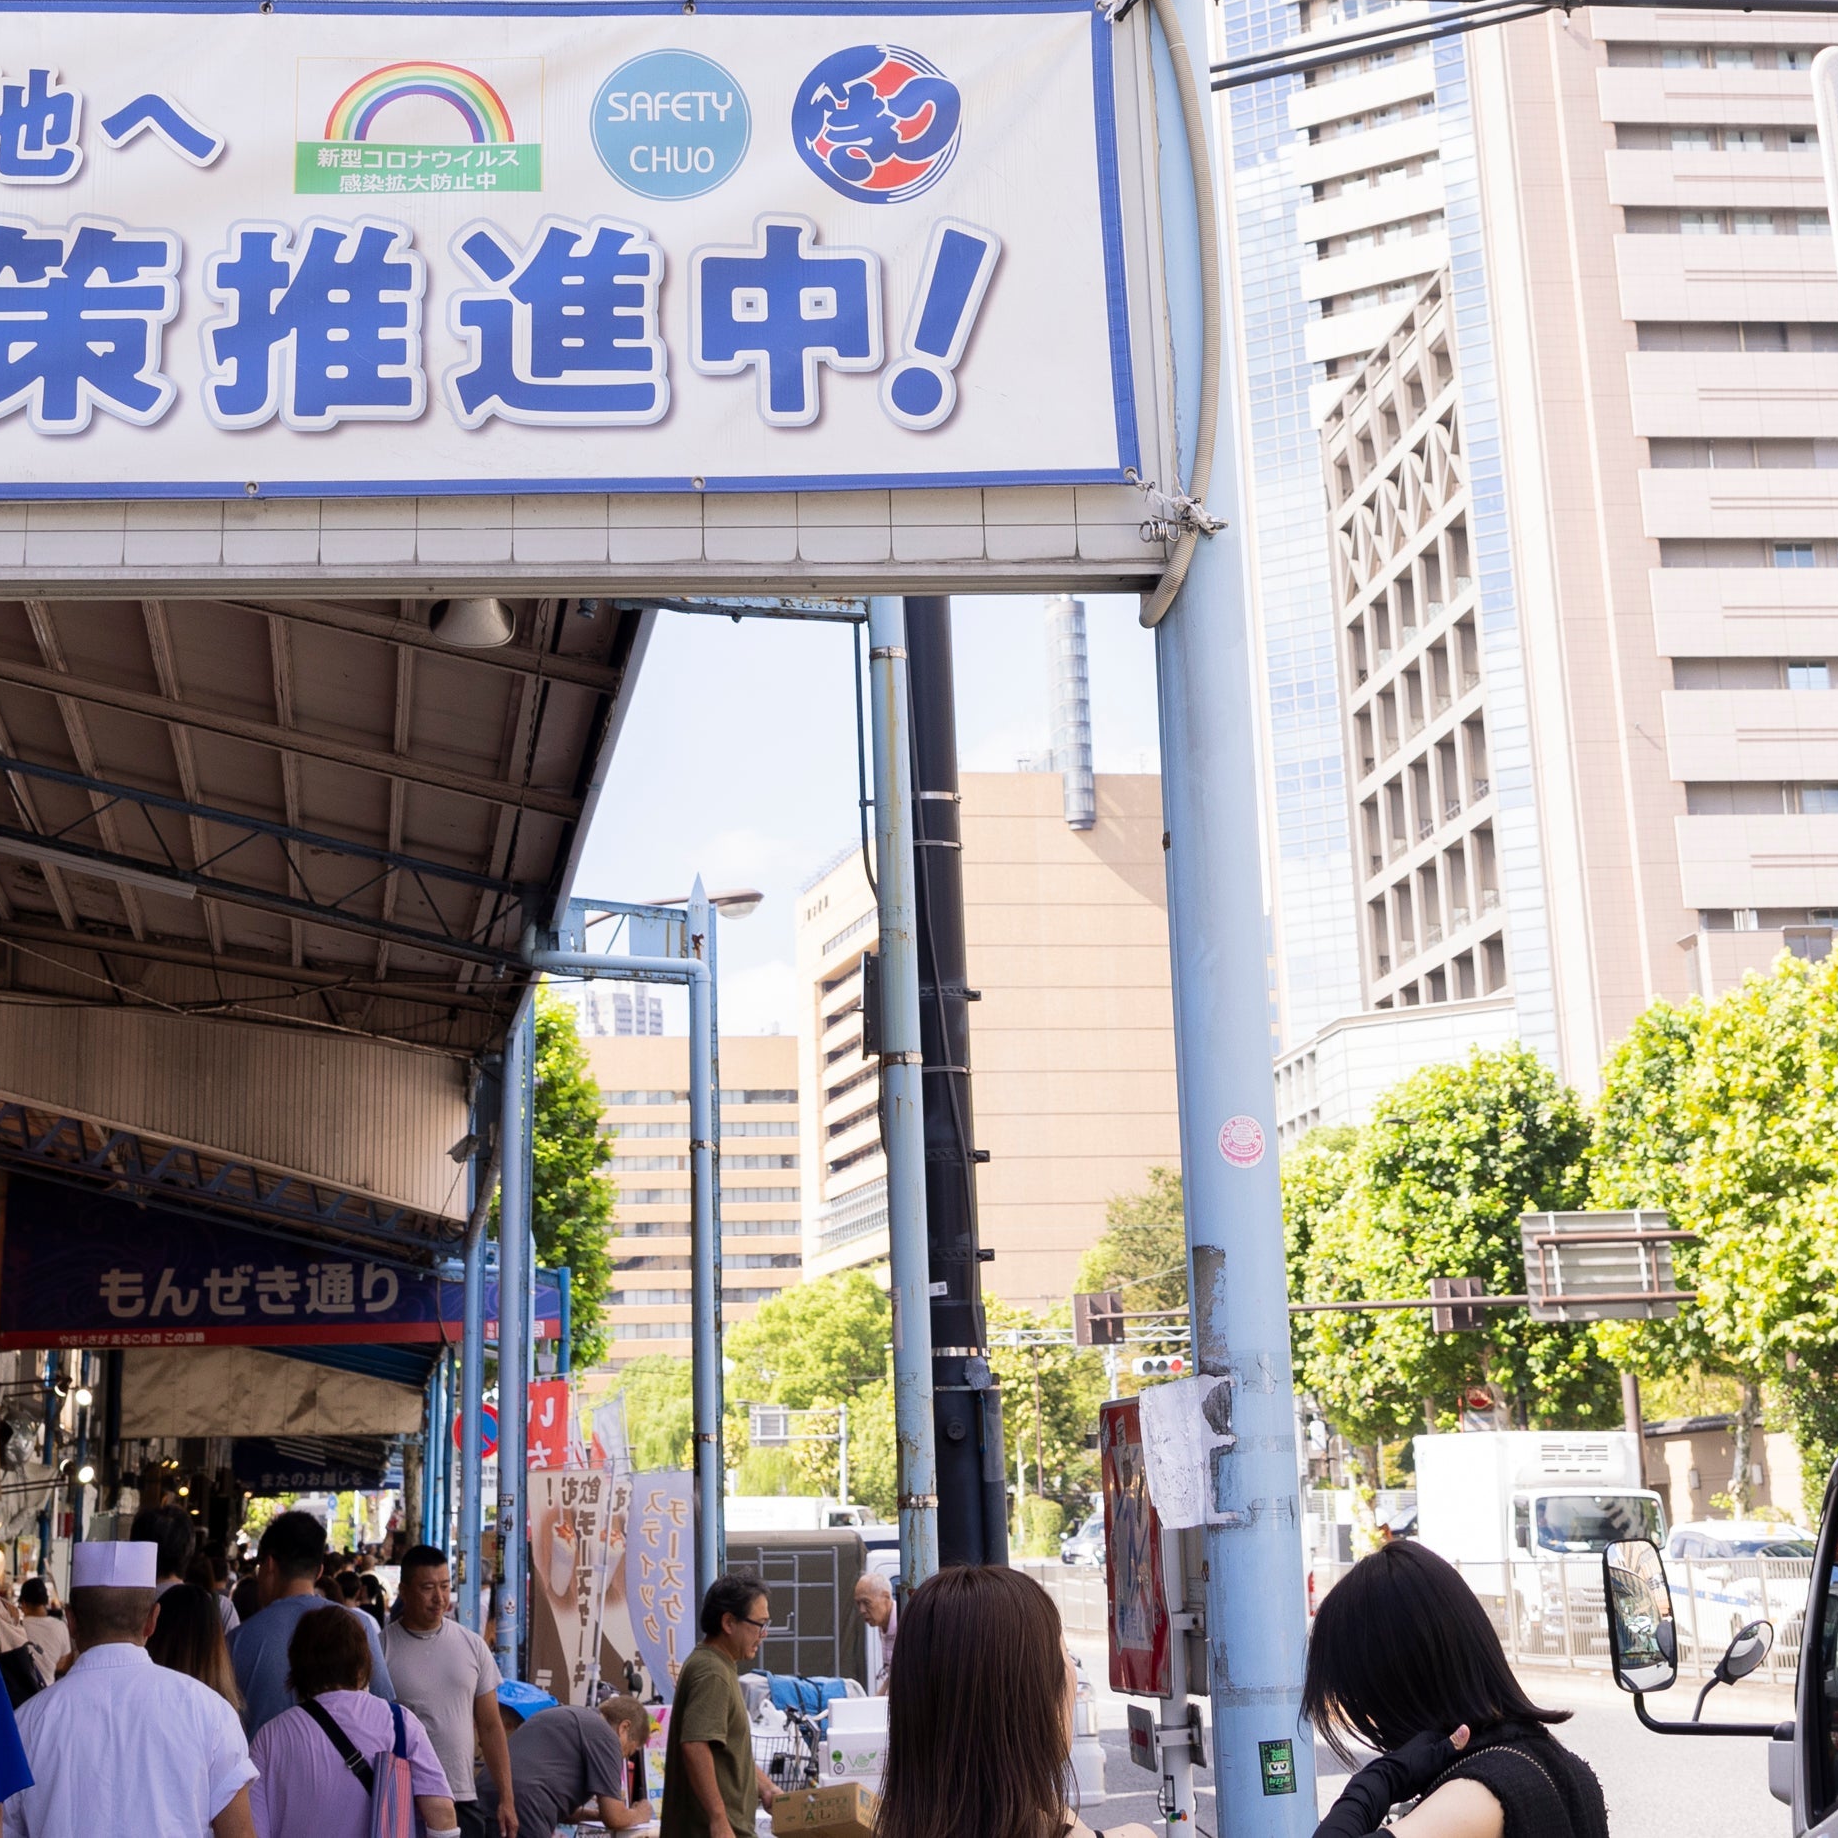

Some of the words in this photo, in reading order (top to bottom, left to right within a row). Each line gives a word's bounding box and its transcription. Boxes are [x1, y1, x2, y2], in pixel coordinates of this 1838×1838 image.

[607, 90, 733, 123] SAFETY
[316, 146, 521, 170] 新型コロナウイルス
[629, 144, 716, 174] CHUO
[337, 171, 499, 194] 感染拡大防止中
[98, 1263, 400, 1320] もんぜき通り
